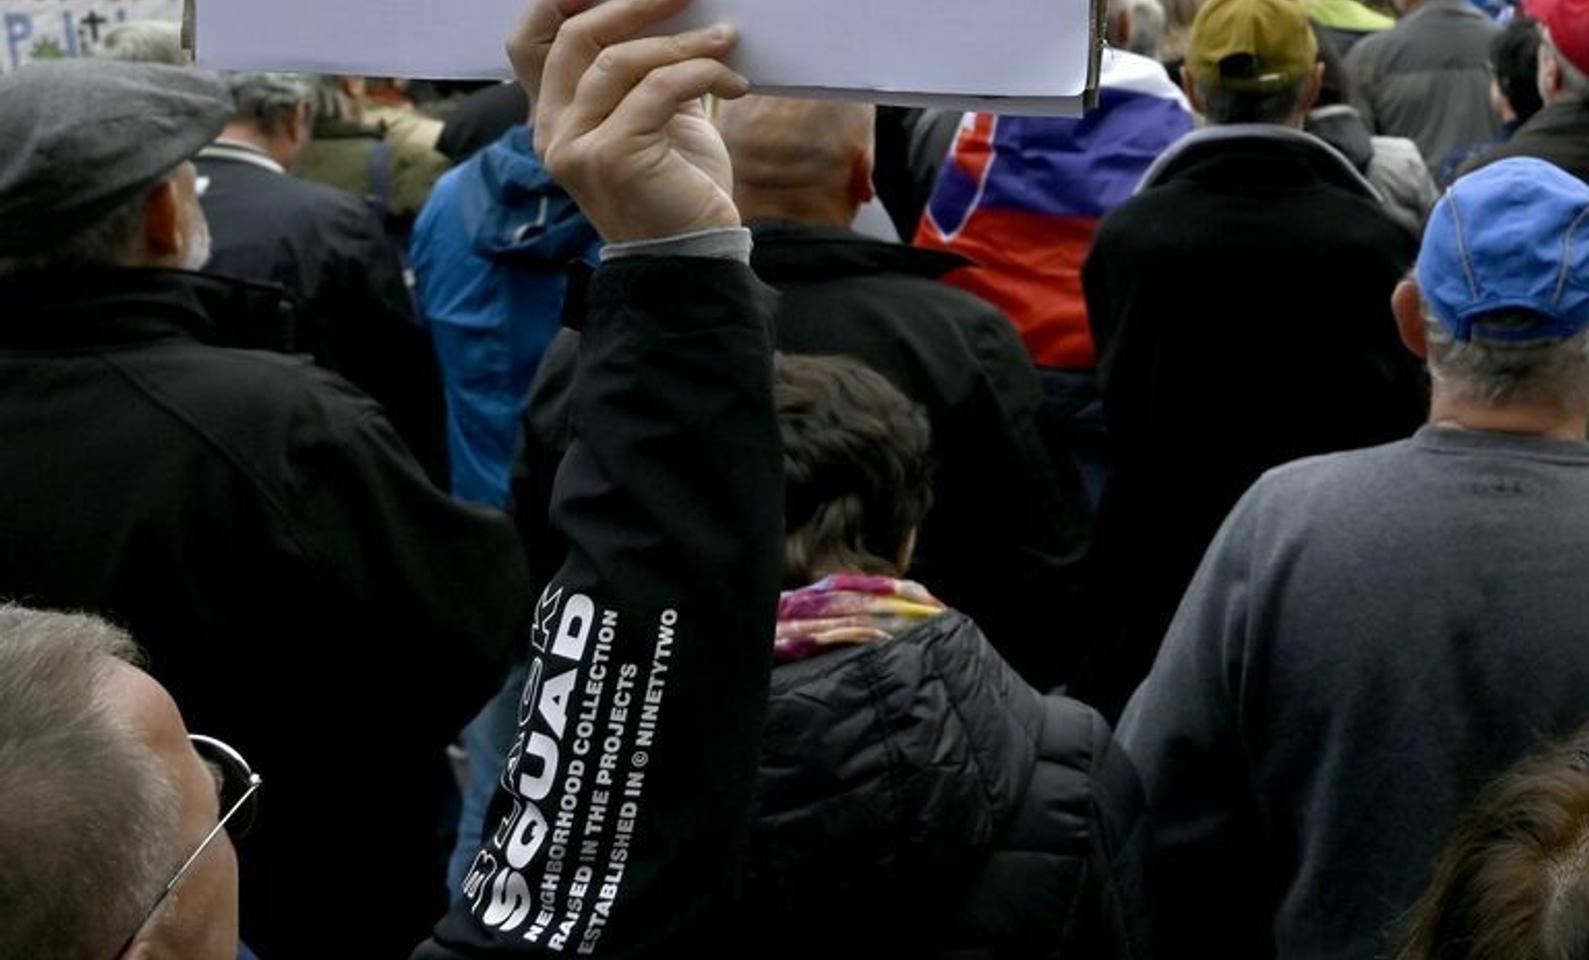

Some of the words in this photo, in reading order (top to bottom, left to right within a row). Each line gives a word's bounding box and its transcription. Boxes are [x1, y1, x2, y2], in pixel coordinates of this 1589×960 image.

[482, 593, 595, 931] SQUAD
[523, 759, 585, 942] NEIGHBORHOOD
[573, 609, 618, 755] COLLECTION
[577, 801, 637, 955] ESTABLISHED
[625, 771, 645, 796] IN
[635, 608, 678, 746] NINETYTWO
[595, 663, 638, 786] PROJECTS
[580, 839, 599, 862] IN
[585, 790, 610, 835] THE
[548, 866, 593, 951] RAISED
